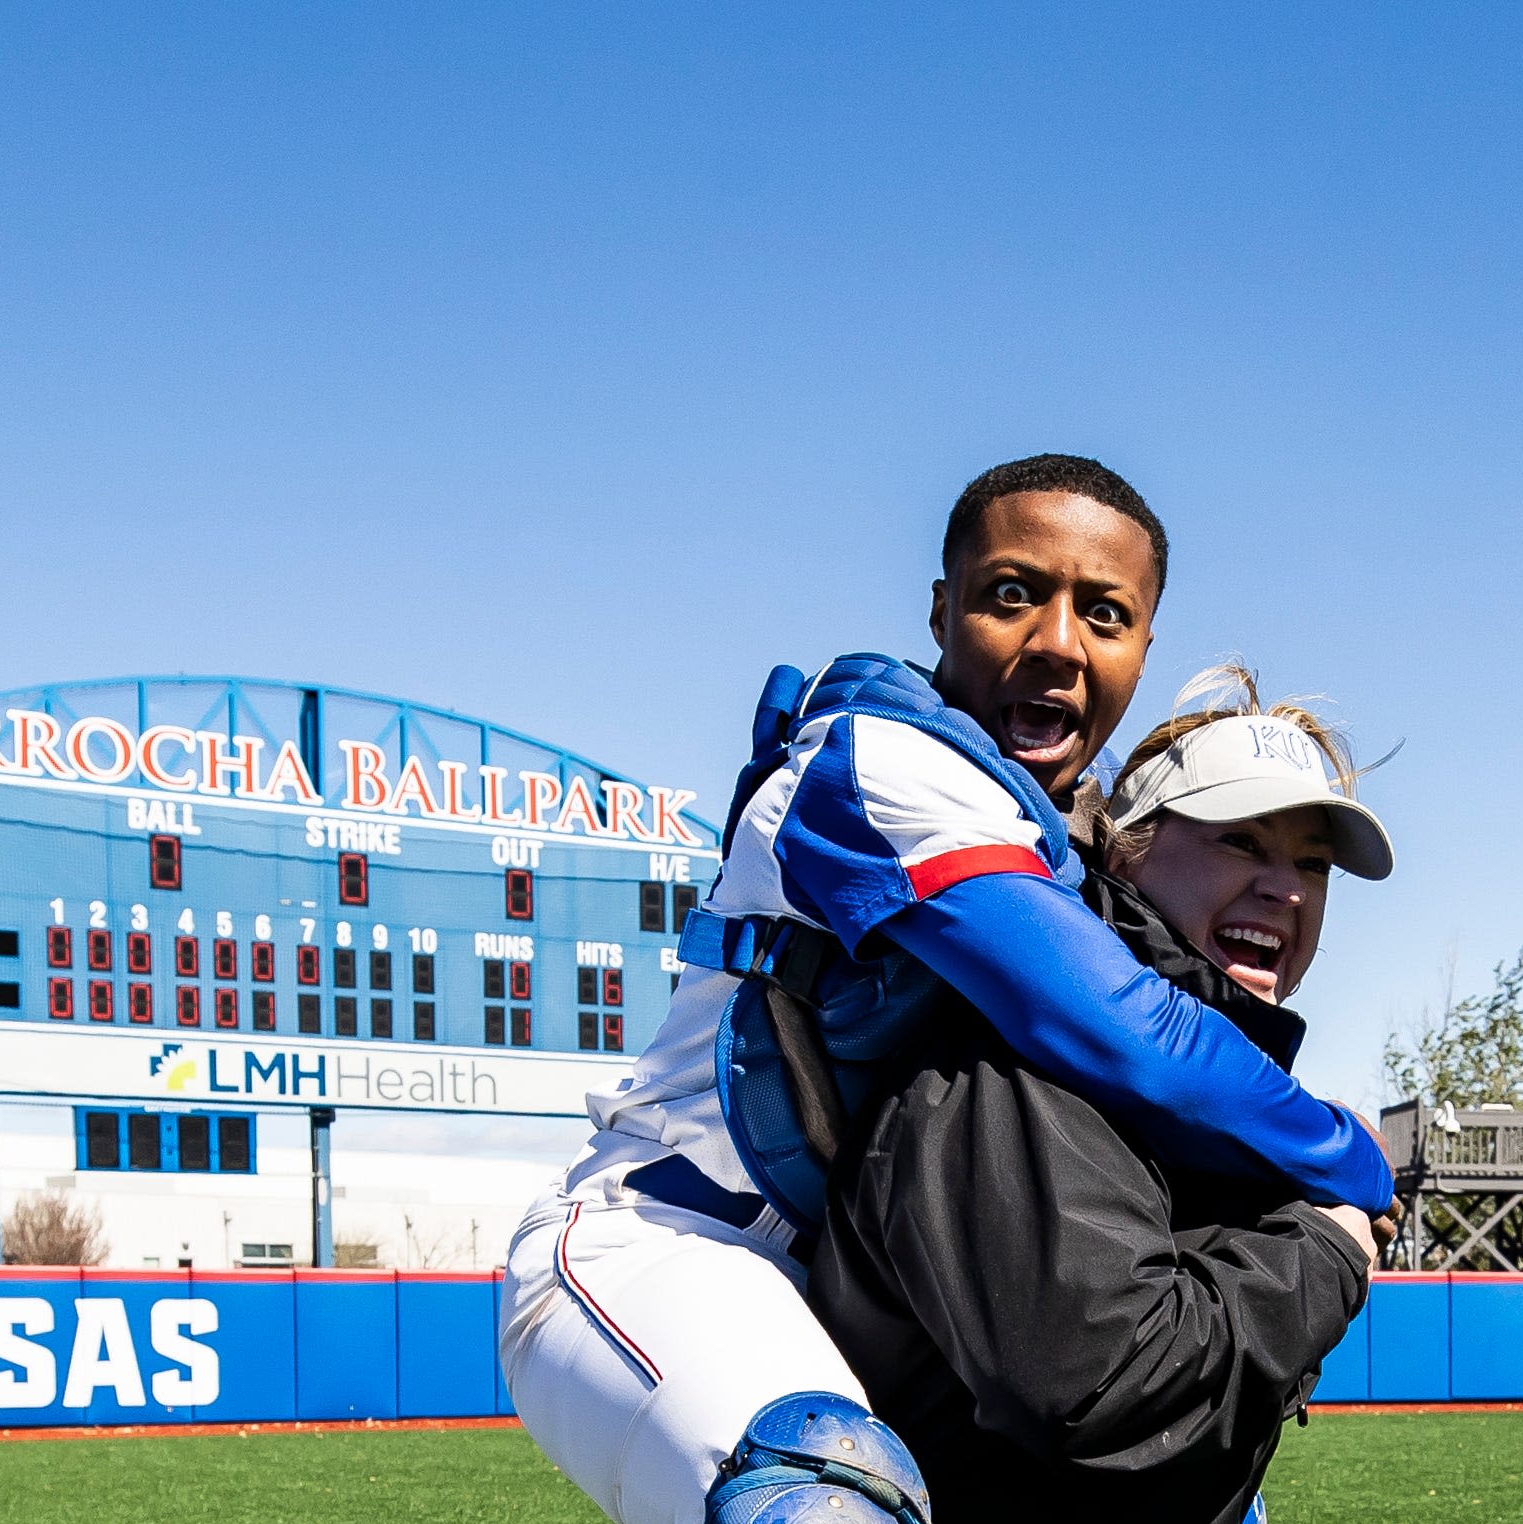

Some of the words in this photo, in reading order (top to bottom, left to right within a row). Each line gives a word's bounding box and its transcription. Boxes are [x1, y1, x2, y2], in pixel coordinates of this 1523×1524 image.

[127, 798, 202, 836] BALL
[338, 739, 703, 848] BALLPARK
[152, 835, 180, 888] 0
[305, 816, 402, 856] STRIKE
[491, 836, 544, 868] OUT
[340, 853, 367, 904] 0
[507, 869, 532, 918] 0
[649, 853, 690, 883] H/E
[49, 897, 64, 925] 1
[89, 900, 107, 928] 2
[131, 903, 149, 931] 3
[177, 908, 195, 934] 4
[216, 911, 233, 938] 5
[255, 914, 272, 941] 6
[299, 918, 316, 944] 7
[336, 922, 352, 947] 8
[372, 924, 388, 950] 9
[408, 927, 438, 954] 10
[474, 932, 534, 961] RUNS
[576, 941, 624, 968] HITS
[49, 927, 72, 968] 0
[89, 930, 112, 971] 0
[129, 932, 152, 973] 0
[177, 936, 199, 976] 0
[215, 940, 237, 979] 0
[253, 943, 274, 980] 0
[299, 947, 319, 984] 0
[511, 962, 530, 997] 0
[603, 969, 622, 1004] 6
[49, 978, 73, 1018] 0
[90, 980, 113, 1021] 0
[130, 982, 152, 1022] 0
[178, 986, 200, 1026] 0
[216, 988, 238, 1028] 0
[605, 1017, 622, 1047] 4
[209, 1049, 326, 1096] LMH
[336, 1055, 498, 1106] Health
